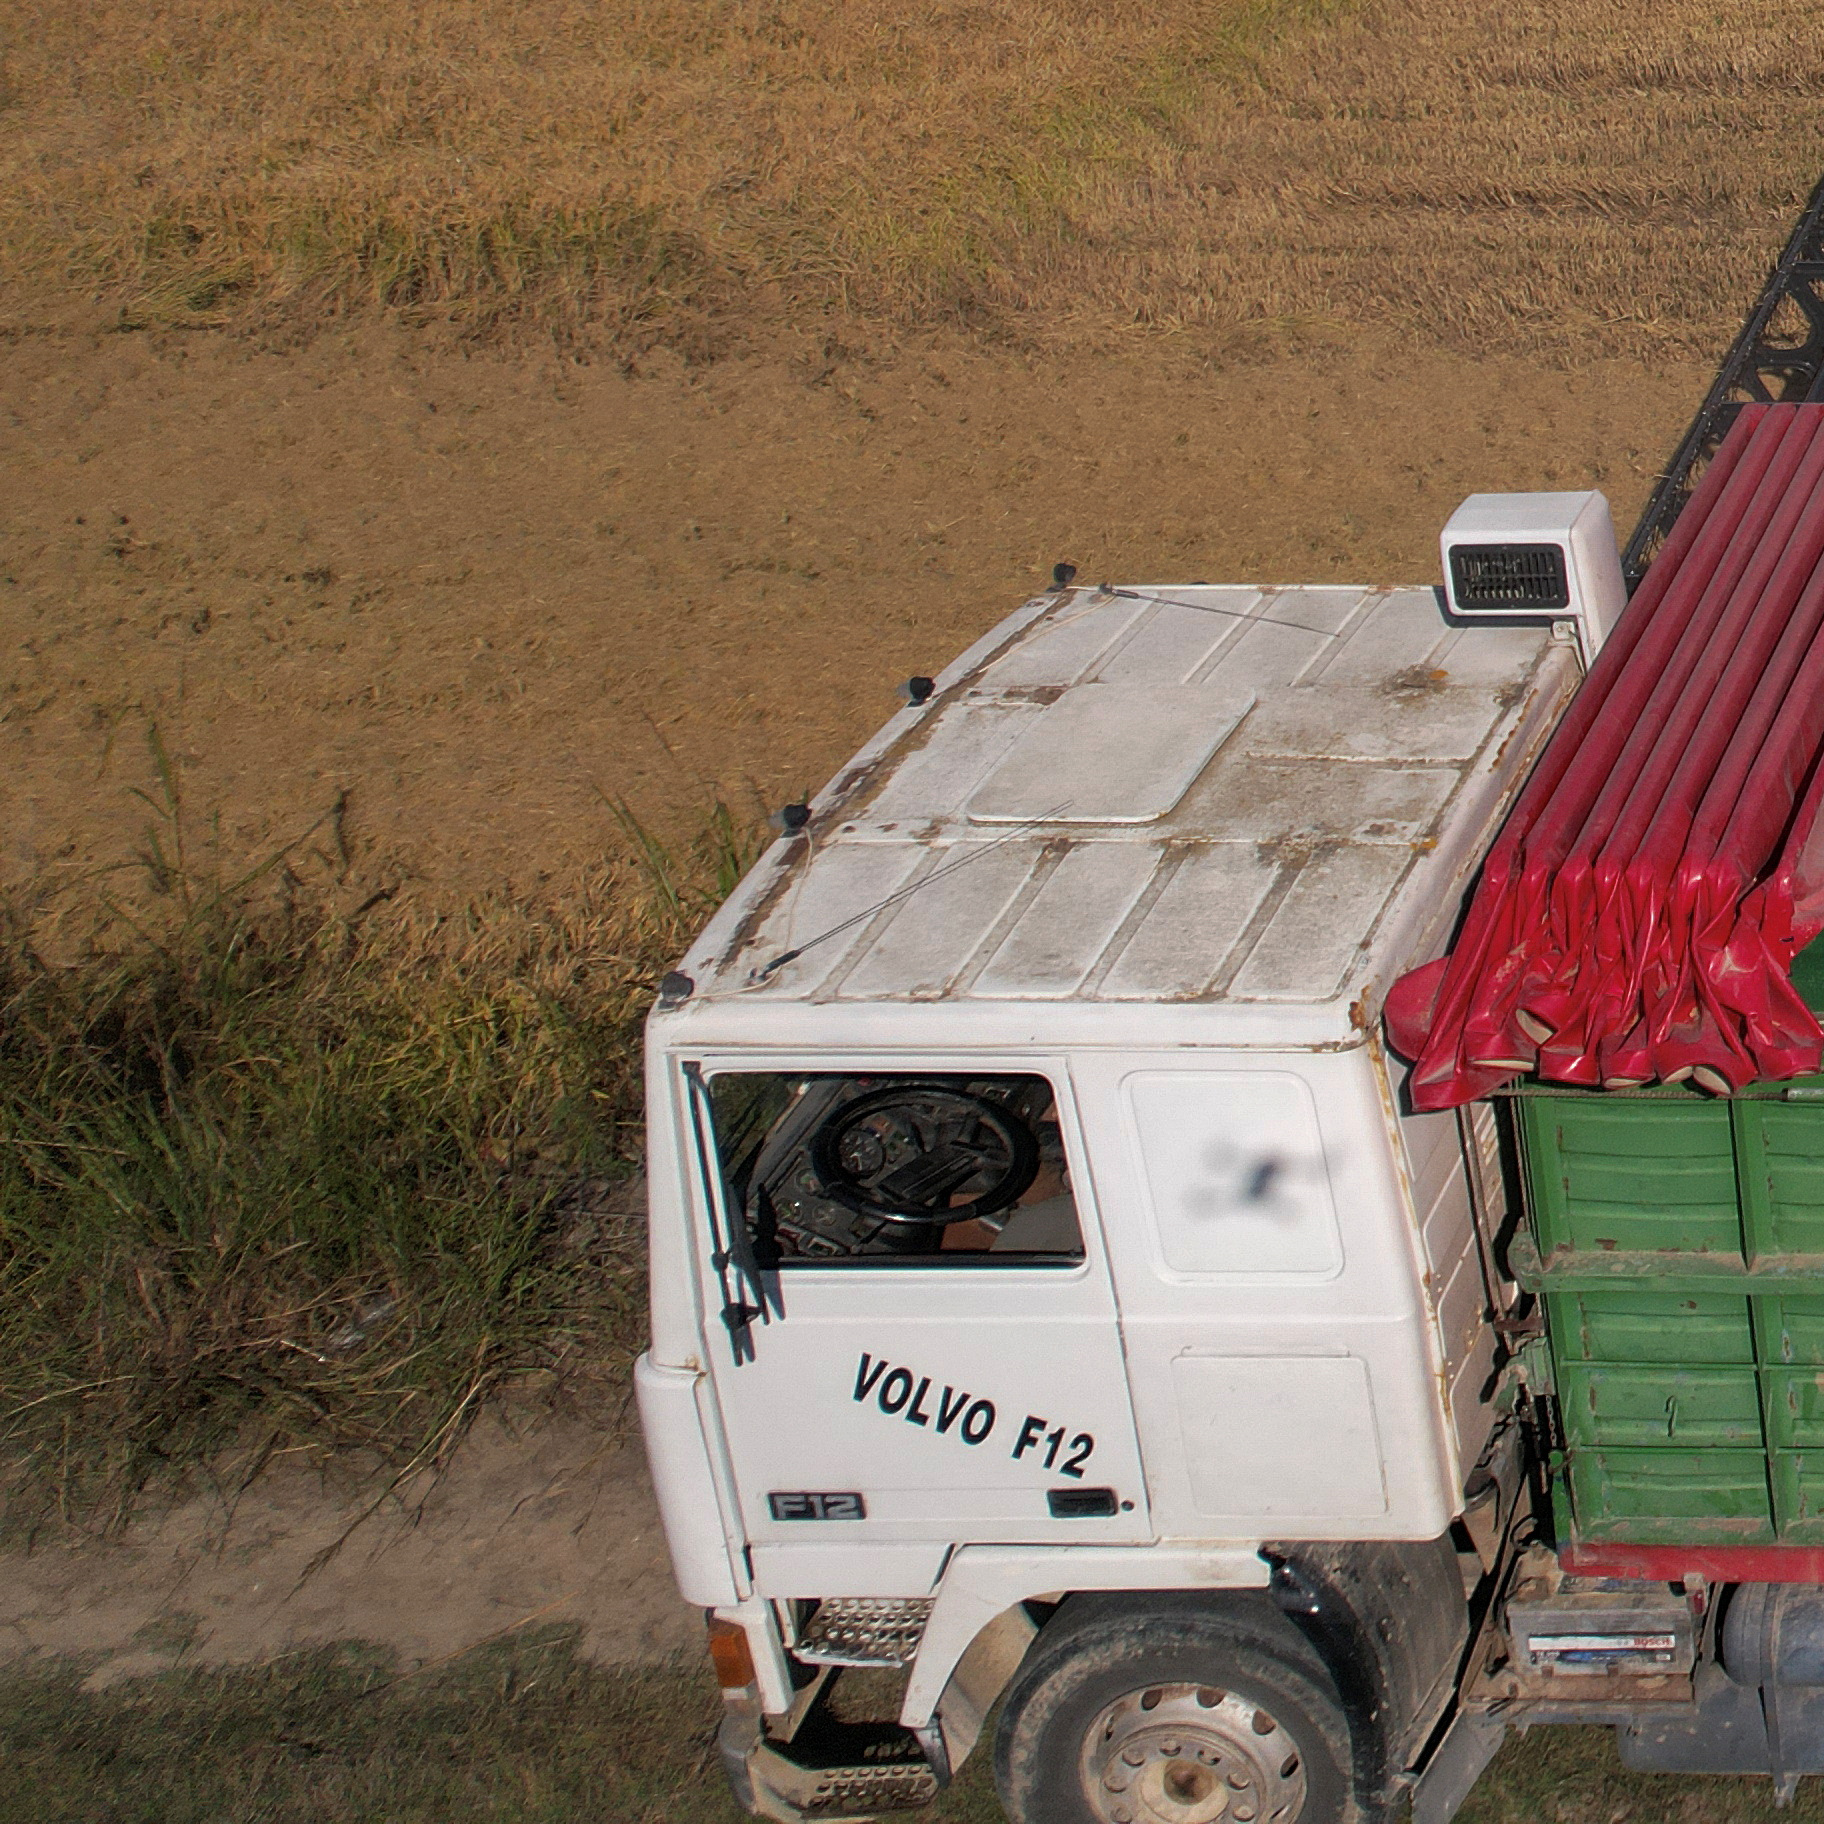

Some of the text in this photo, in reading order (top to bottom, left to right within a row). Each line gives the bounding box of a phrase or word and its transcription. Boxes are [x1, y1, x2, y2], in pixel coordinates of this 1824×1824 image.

[853, 1352, 1095, 1479] VOLVO F12
[773, 1495, 859, 1518] F12
